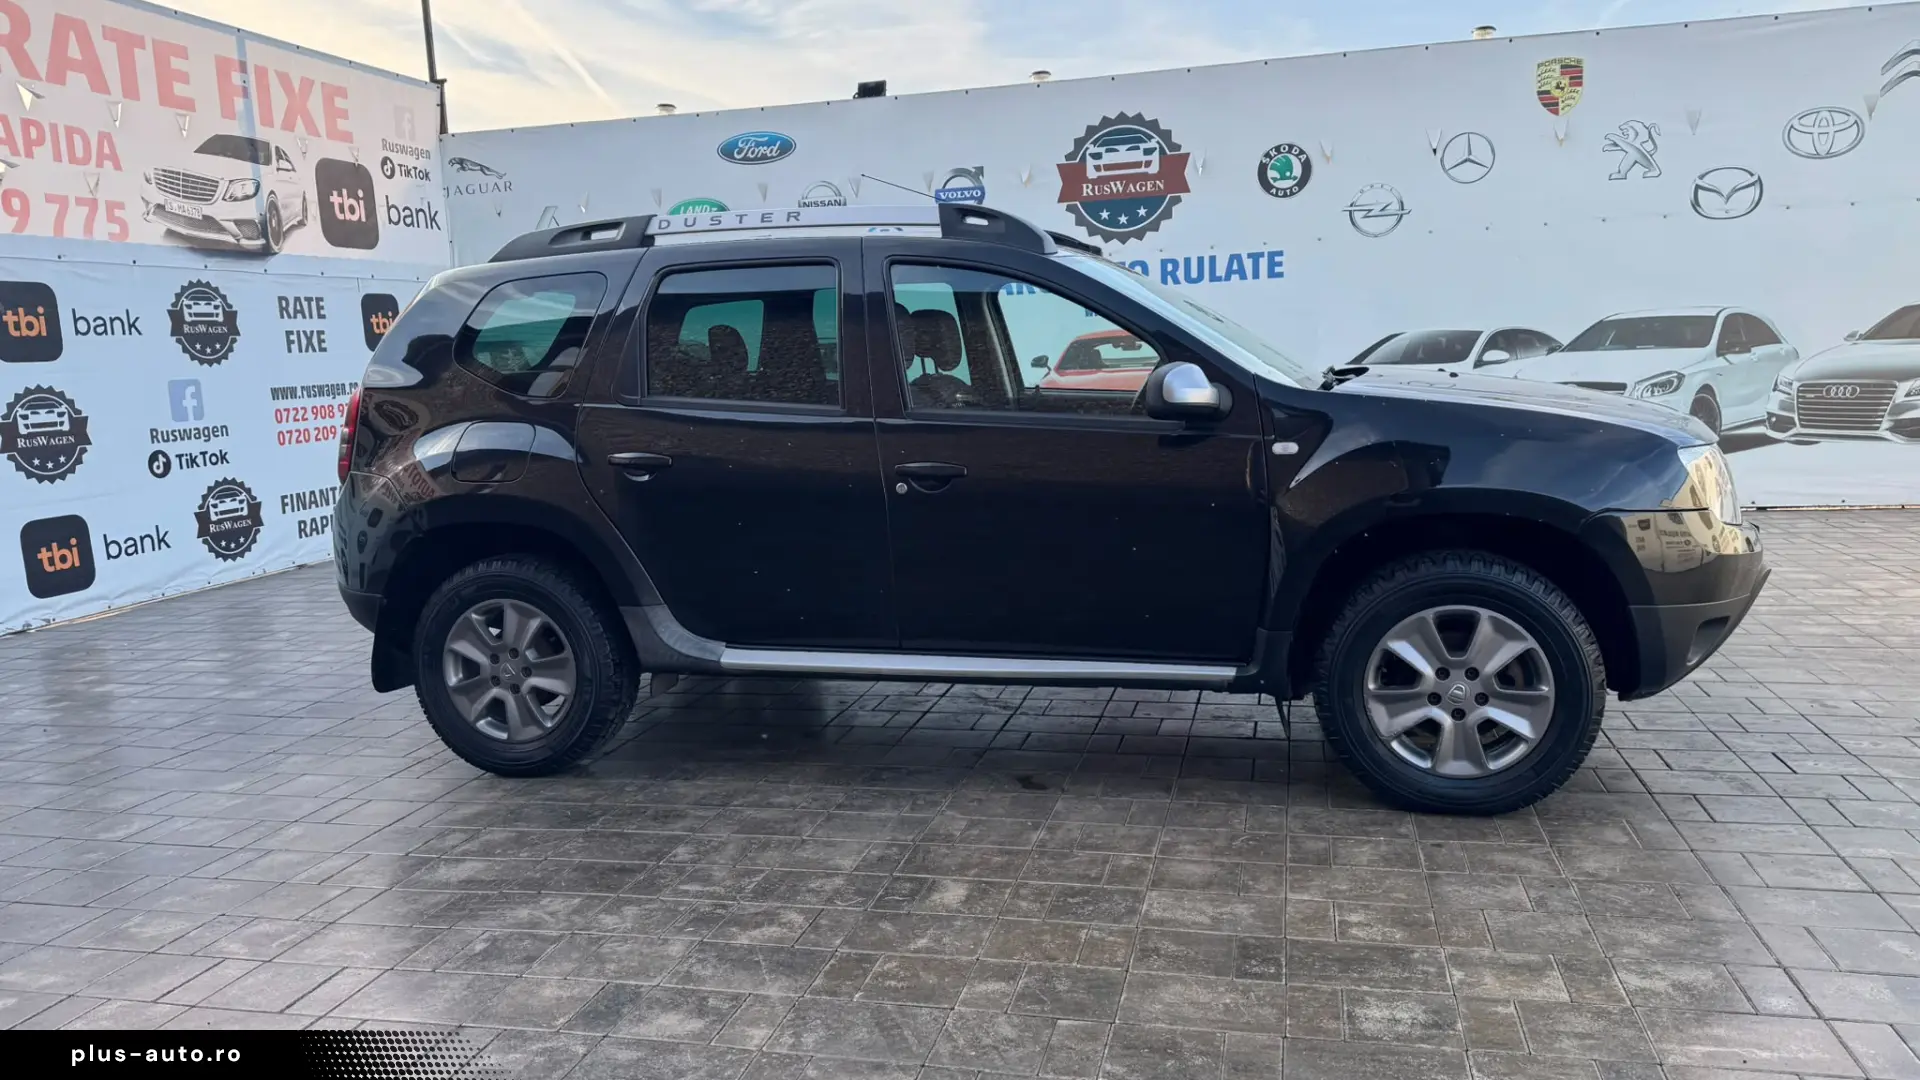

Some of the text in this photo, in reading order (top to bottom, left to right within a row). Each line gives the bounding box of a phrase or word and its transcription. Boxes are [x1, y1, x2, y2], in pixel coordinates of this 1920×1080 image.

[214, 54, 354, 144] FIXE
[381, 138, 431, 161] Ruswagen
[733, 136, 781, 159] Ford
[397, 163, 431, 182] TikTok
[443, 181, 513, 199] JAGUAR
[939, 189, 981, 200] VOLVO
[1270, 186, 1299, 197] AUTO
[329, 188, 442, 231] tbi bank
[802, 199, 842, 208] NISSAN
[44, 192, 129, 242] 775
[657, 211, 801, 230] DUSTER
[1160, 250, 1285, 286] RULATE
[277, 296, 327, 321] RATE
[2, 306, 143, 338] tbi bank
[285, 329, 328, 354] FIXE
[274, 406, 309, 424] 0722
[311, 404, 336, 421] 908
[149, 423, 229, 445] Ruswagen
[277, 425, 338, 446] 0720 209
[175, 449, 230, 471] TikTok
[280, 486, 342, 514] FINANT
[37, 525, 172, 573] tbi bank
